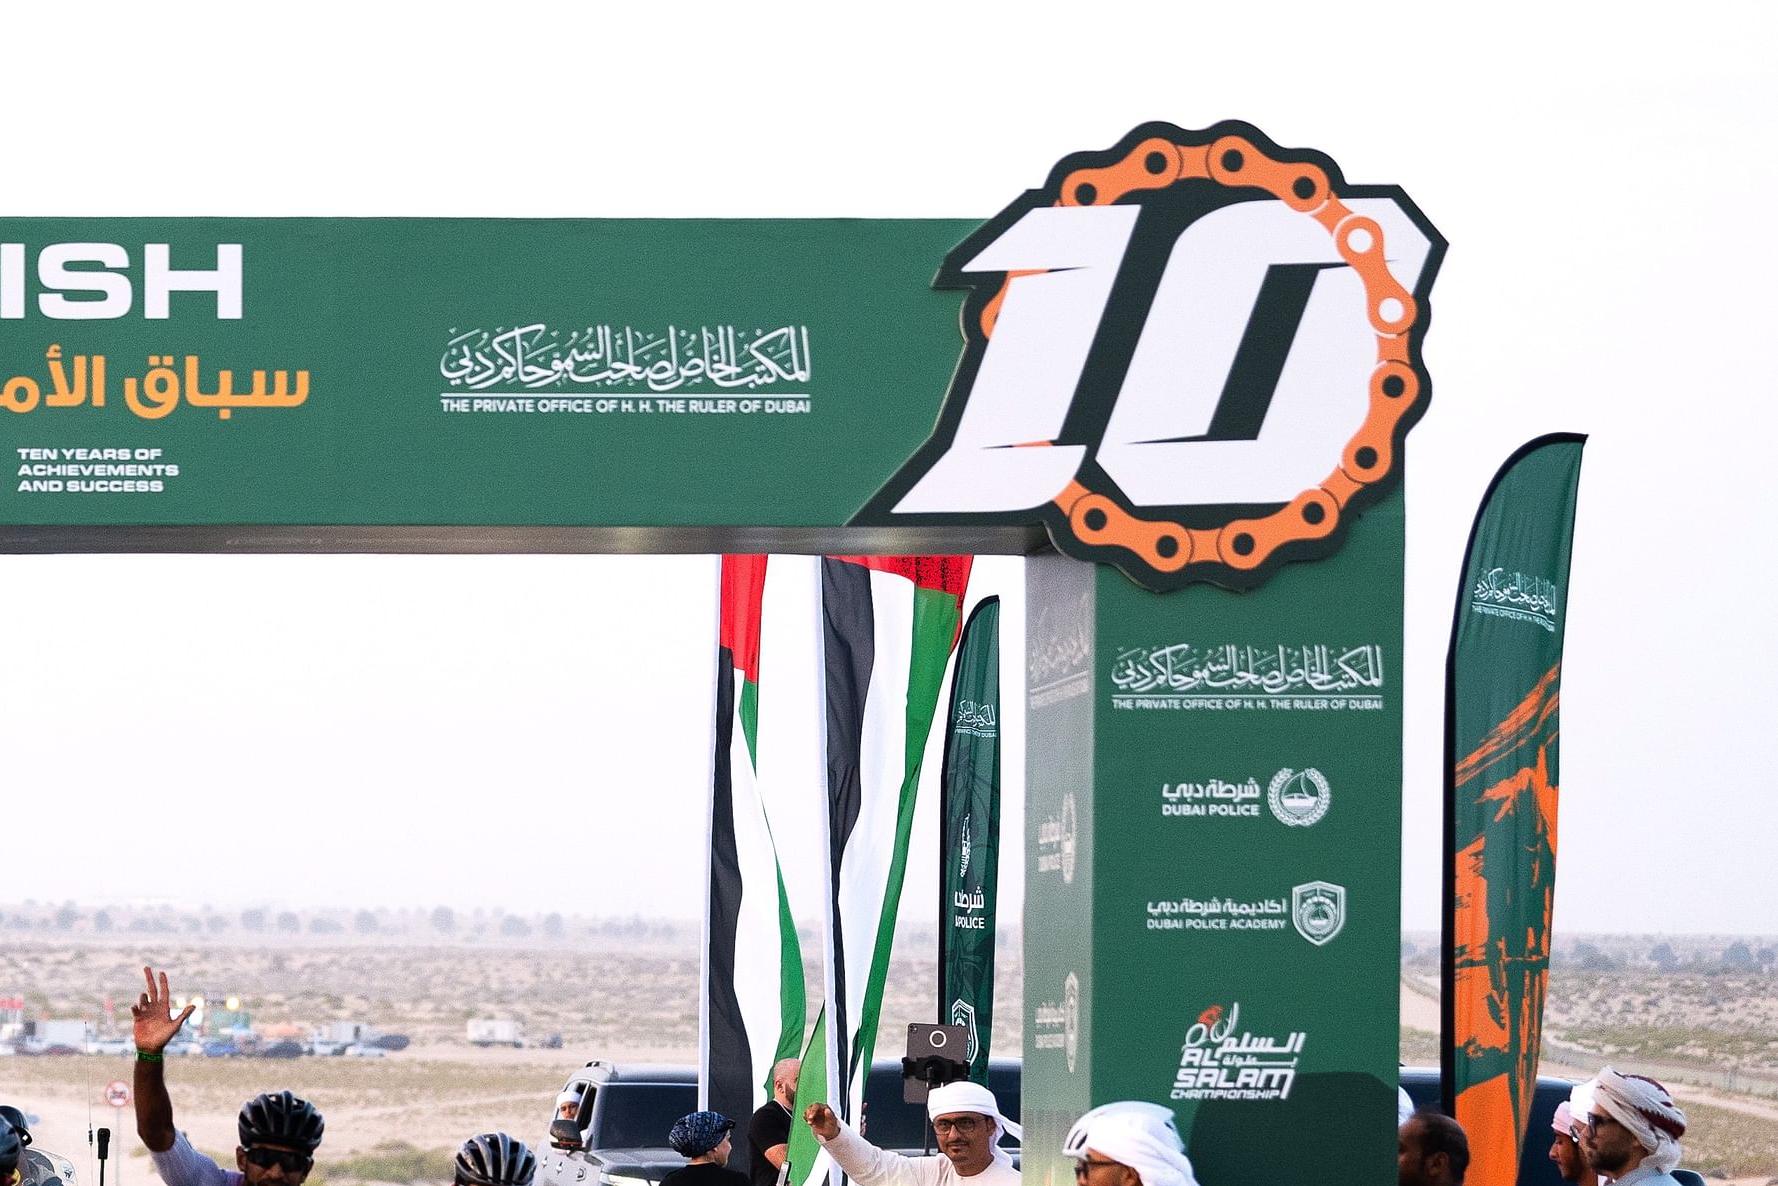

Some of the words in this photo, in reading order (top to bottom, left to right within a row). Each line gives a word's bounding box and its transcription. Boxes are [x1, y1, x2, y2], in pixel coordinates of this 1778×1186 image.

[890, 197, 1432, 513] 10
[123, 354, 311, 420] سباق
[441, 399, 469, 412] THE
[473, 399, 534, 412] PRIVATE
[538, 399, 592, 412] OFFICE
[596, 400, 618, 413] OF
[621, 400, 635, 412] H.
[639, 400, 652, 412] H.
[656, 400, 685, 413] THE
[689, 400, 736, 413] RULER
[739, 400, 761, 413] OF
[765, 400, 810, 413] DUBAI
[17, 448, 57, 460] TEN
[62, 449, 131, 460] YEARS
[135, 449, 161, 460] OF
[18, 464, 179, 476] ACHIEVEMENTS
[18, 480, 63, 492] AND
[67, 480, 163, 492] SUCCESS
[1113, 699, 1133, 709] THE
[1136, 699, 1180, 709] PRIVATE
[1183, 699, 1223, 709] OFFICE
[1225, 699, 1242, 709] OF
[1244, 700, 1254, 708] H.
[1257, 700, 1267, 709] H.
[1270, 699, 1291, 709] THE
[1293, 699, 1328, 709] RULER
[1330, 699, 1347, 709] OF
[1349, 699, 1382, 709] DUBAI
[1163, 784, 1204, 802] دبي
[1205, 777, 1260, 802] شرطة
[1162, 804, 1206, 815] DUBAI
[1209, 804, 1259, 816] POLICE
[1147, 902, 1179, 916] دبي
[1179, 897, 1221, 916] شرطة
[1223, 899, 1287, 916] أكاديمية
[1147, 919, 1183, 929] DUBAI
[1186, 919, 1226, 929] POLICE
[1230, 919, 1286, 929] ACADEMY
[1180, 1048, 1219, 1067] AL
[1174, 1068, 1295, 1100] SALAM
